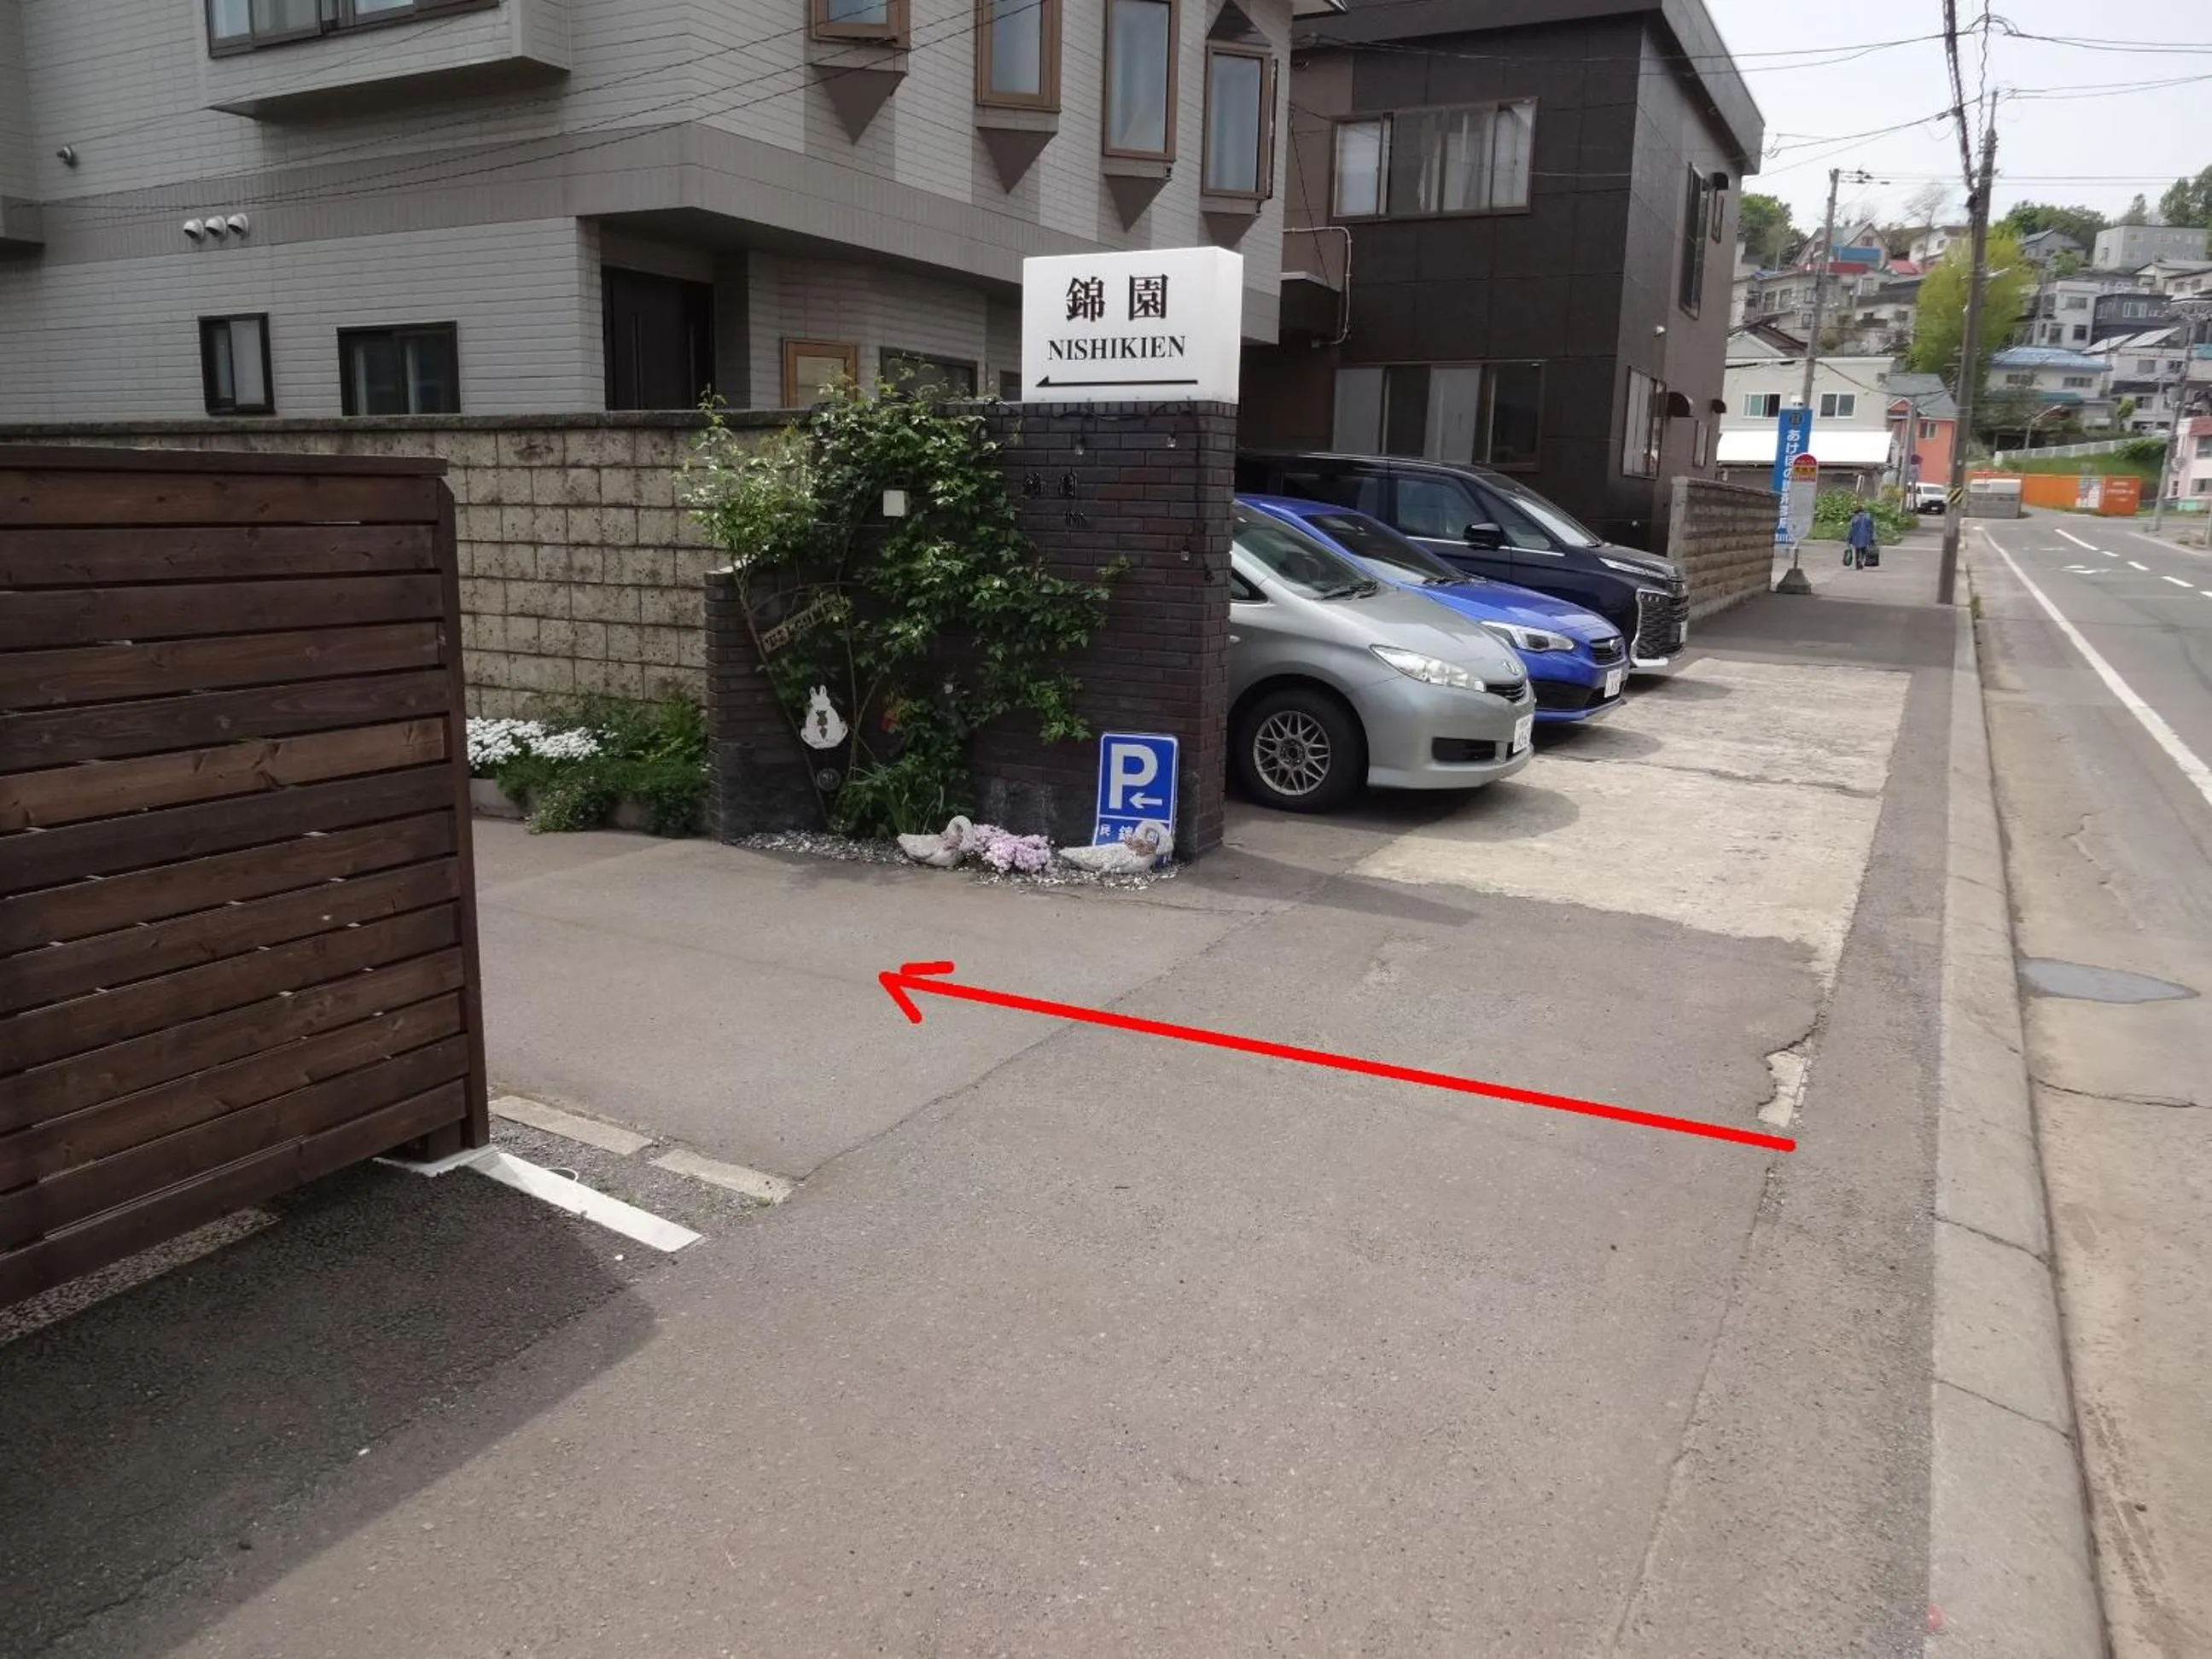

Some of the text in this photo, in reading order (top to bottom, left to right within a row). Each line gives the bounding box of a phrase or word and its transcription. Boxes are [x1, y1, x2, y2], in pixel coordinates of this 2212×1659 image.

[1066, 274, 1168, 322] 錦園
[1048, 335, 1185, 361] NISHIKIEN
[1109, 743, 1158, 809] P
